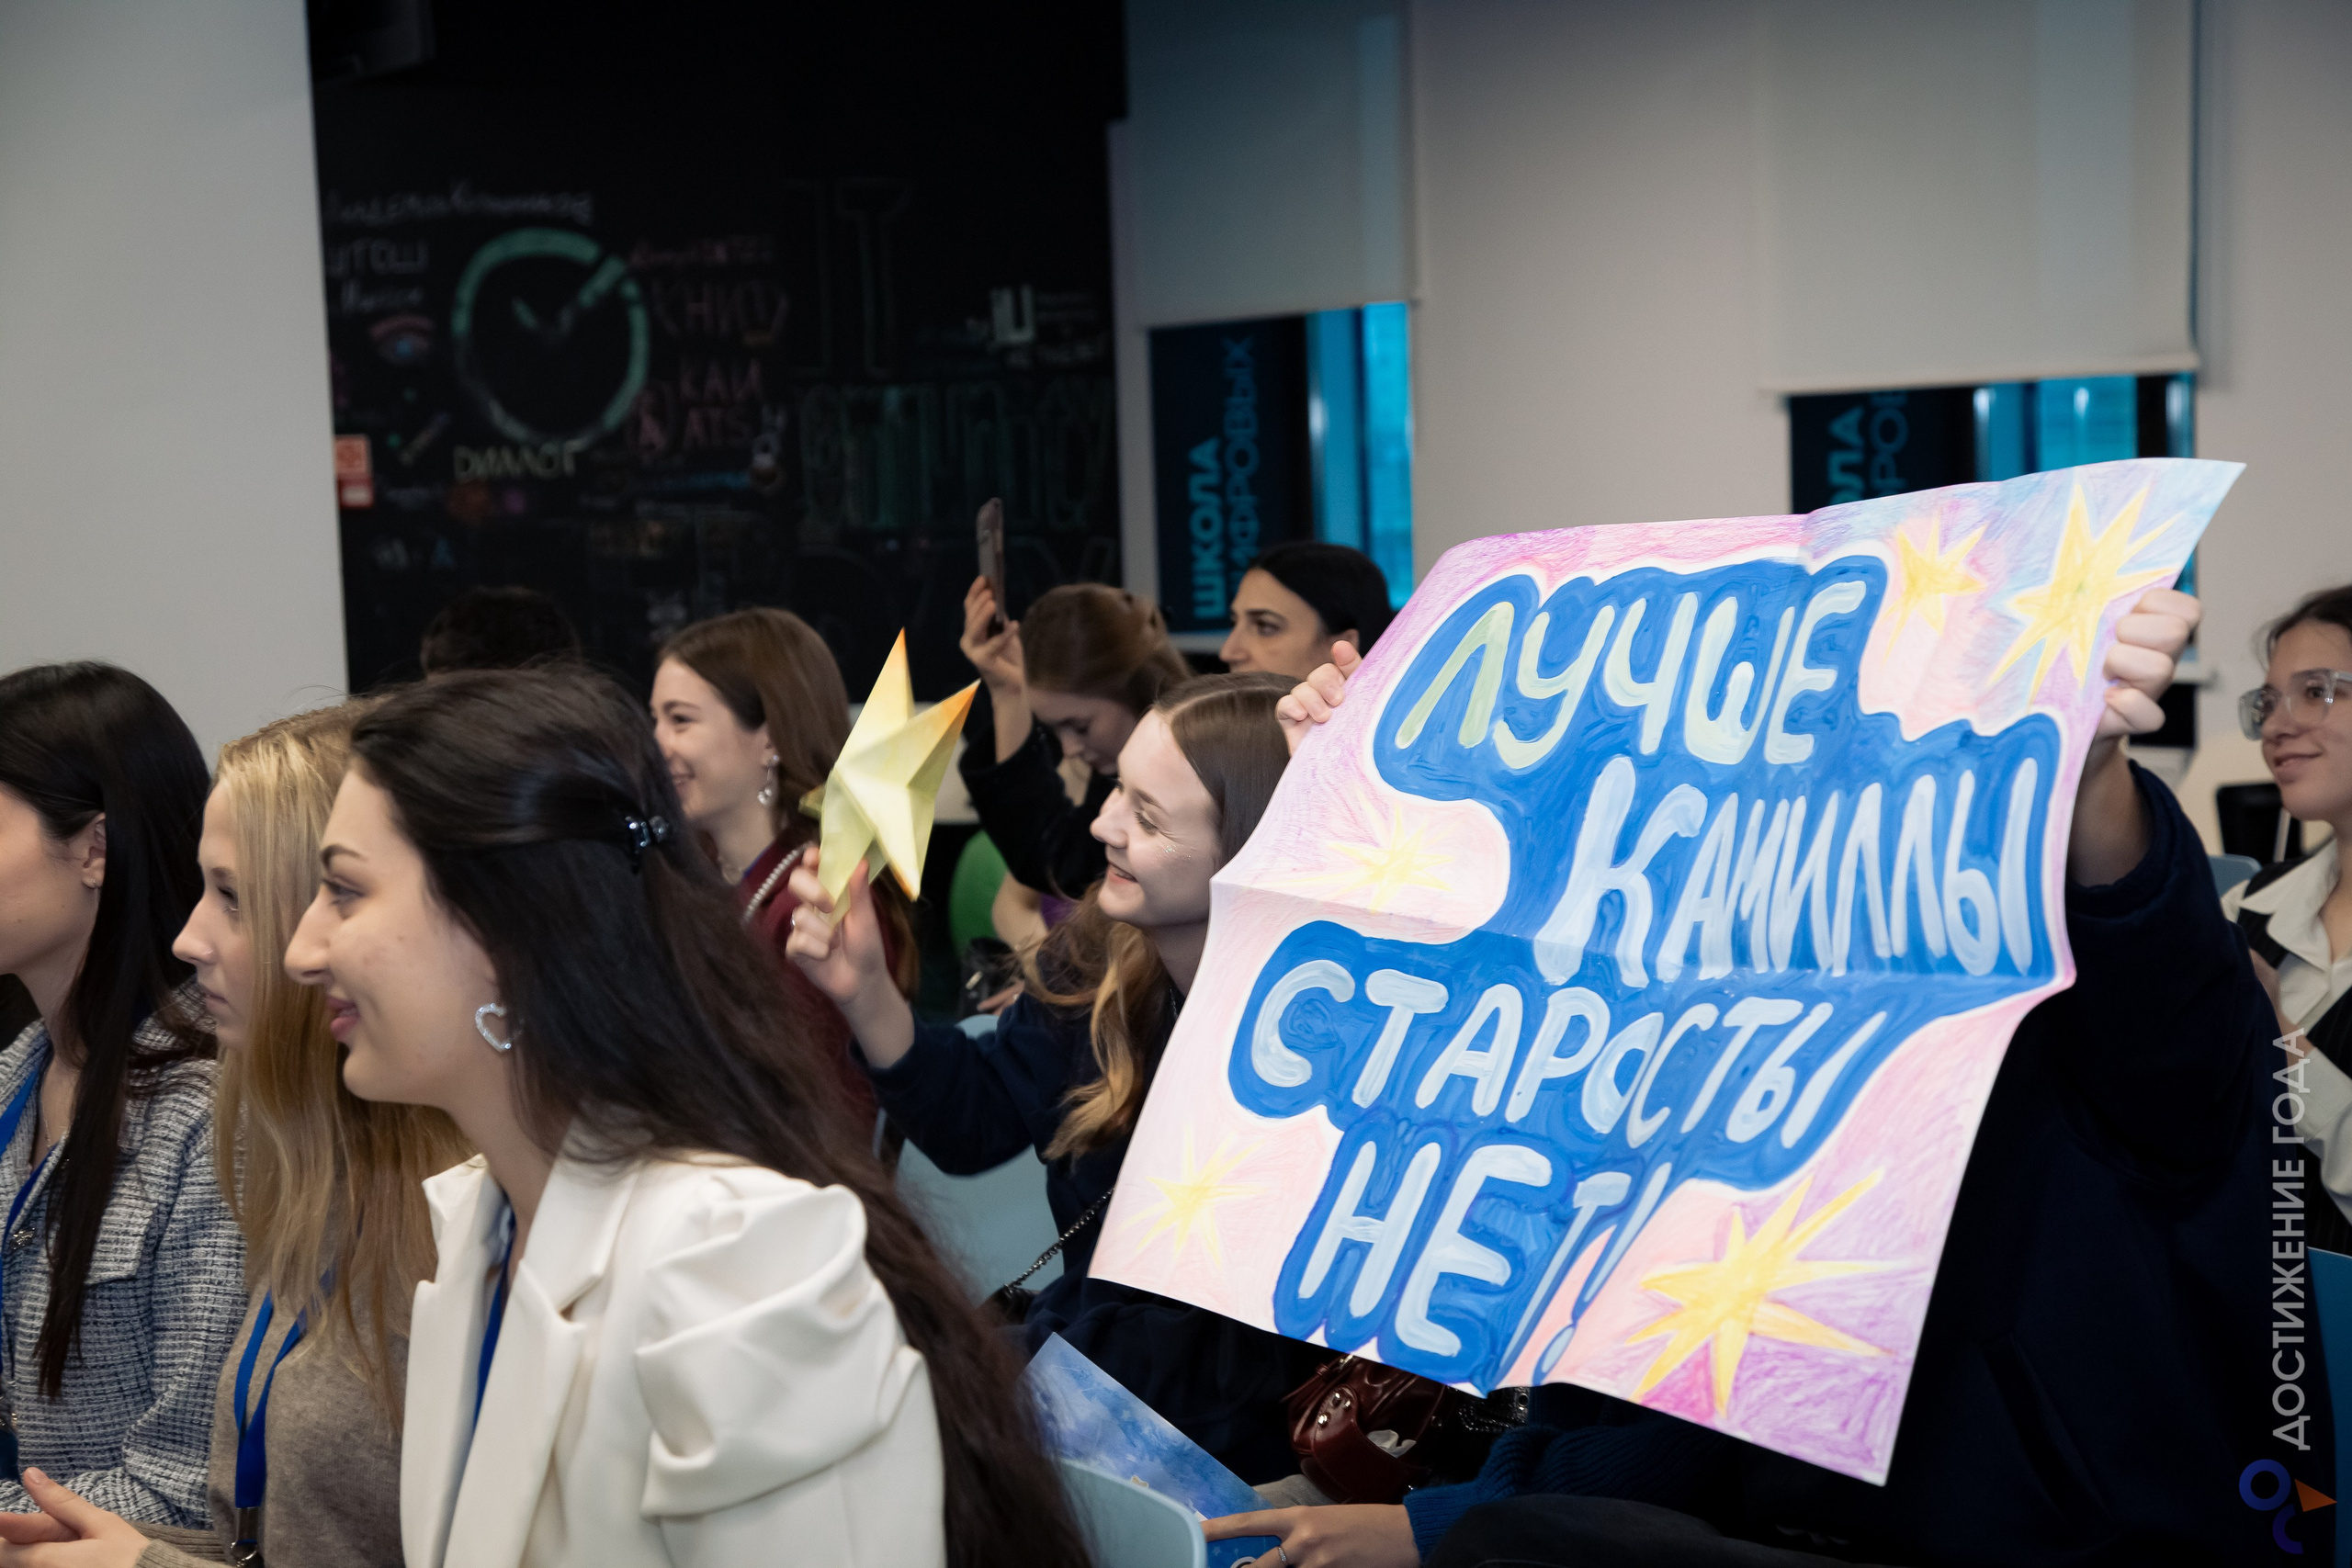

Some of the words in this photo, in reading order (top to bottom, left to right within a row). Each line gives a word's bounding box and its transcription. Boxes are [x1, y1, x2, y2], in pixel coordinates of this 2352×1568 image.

[1189, 436, 1225, 611] ШКОЛА
[1224, 334, 1260, 592] ИФРОВЫХ
[1396, 579, 1868, 770] ЛУЧШЕ
[1532, 755, 2040, 988] КАМИЛЛЫ
[1250, 960, 1886, 1147] СТАРОСТЫ
[1296, 1140, 1673, 1374] НЕТ!
